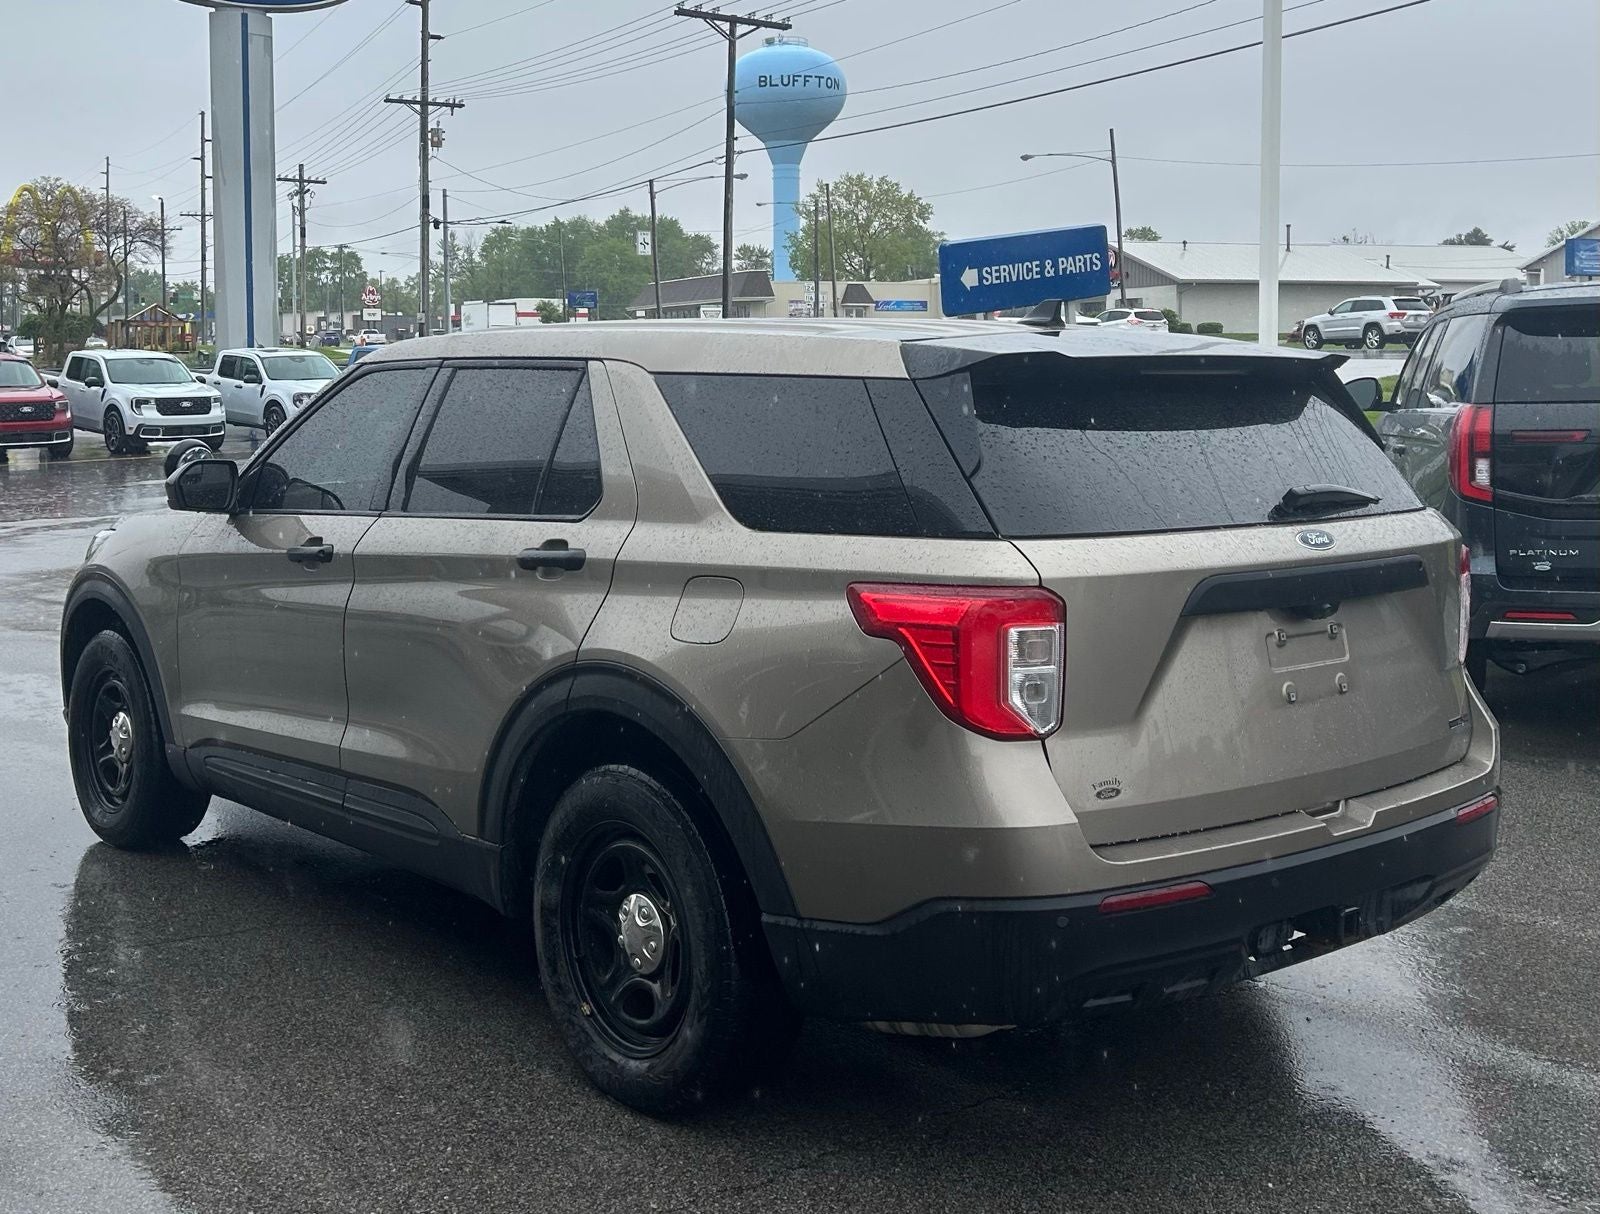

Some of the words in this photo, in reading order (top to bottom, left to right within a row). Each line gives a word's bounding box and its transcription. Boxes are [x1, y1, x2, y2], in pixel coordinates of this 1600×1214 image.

[758, 74, 840, 91] BLUFFTON
[982, 260, 1041, 286] SERVICE
[1044, 259, 1055, 278] &
[1058, 252, 1102, 276] PARTS
[1306, 532, 1330, 545] Ford
[1091, 777, 1121, 790] Family
